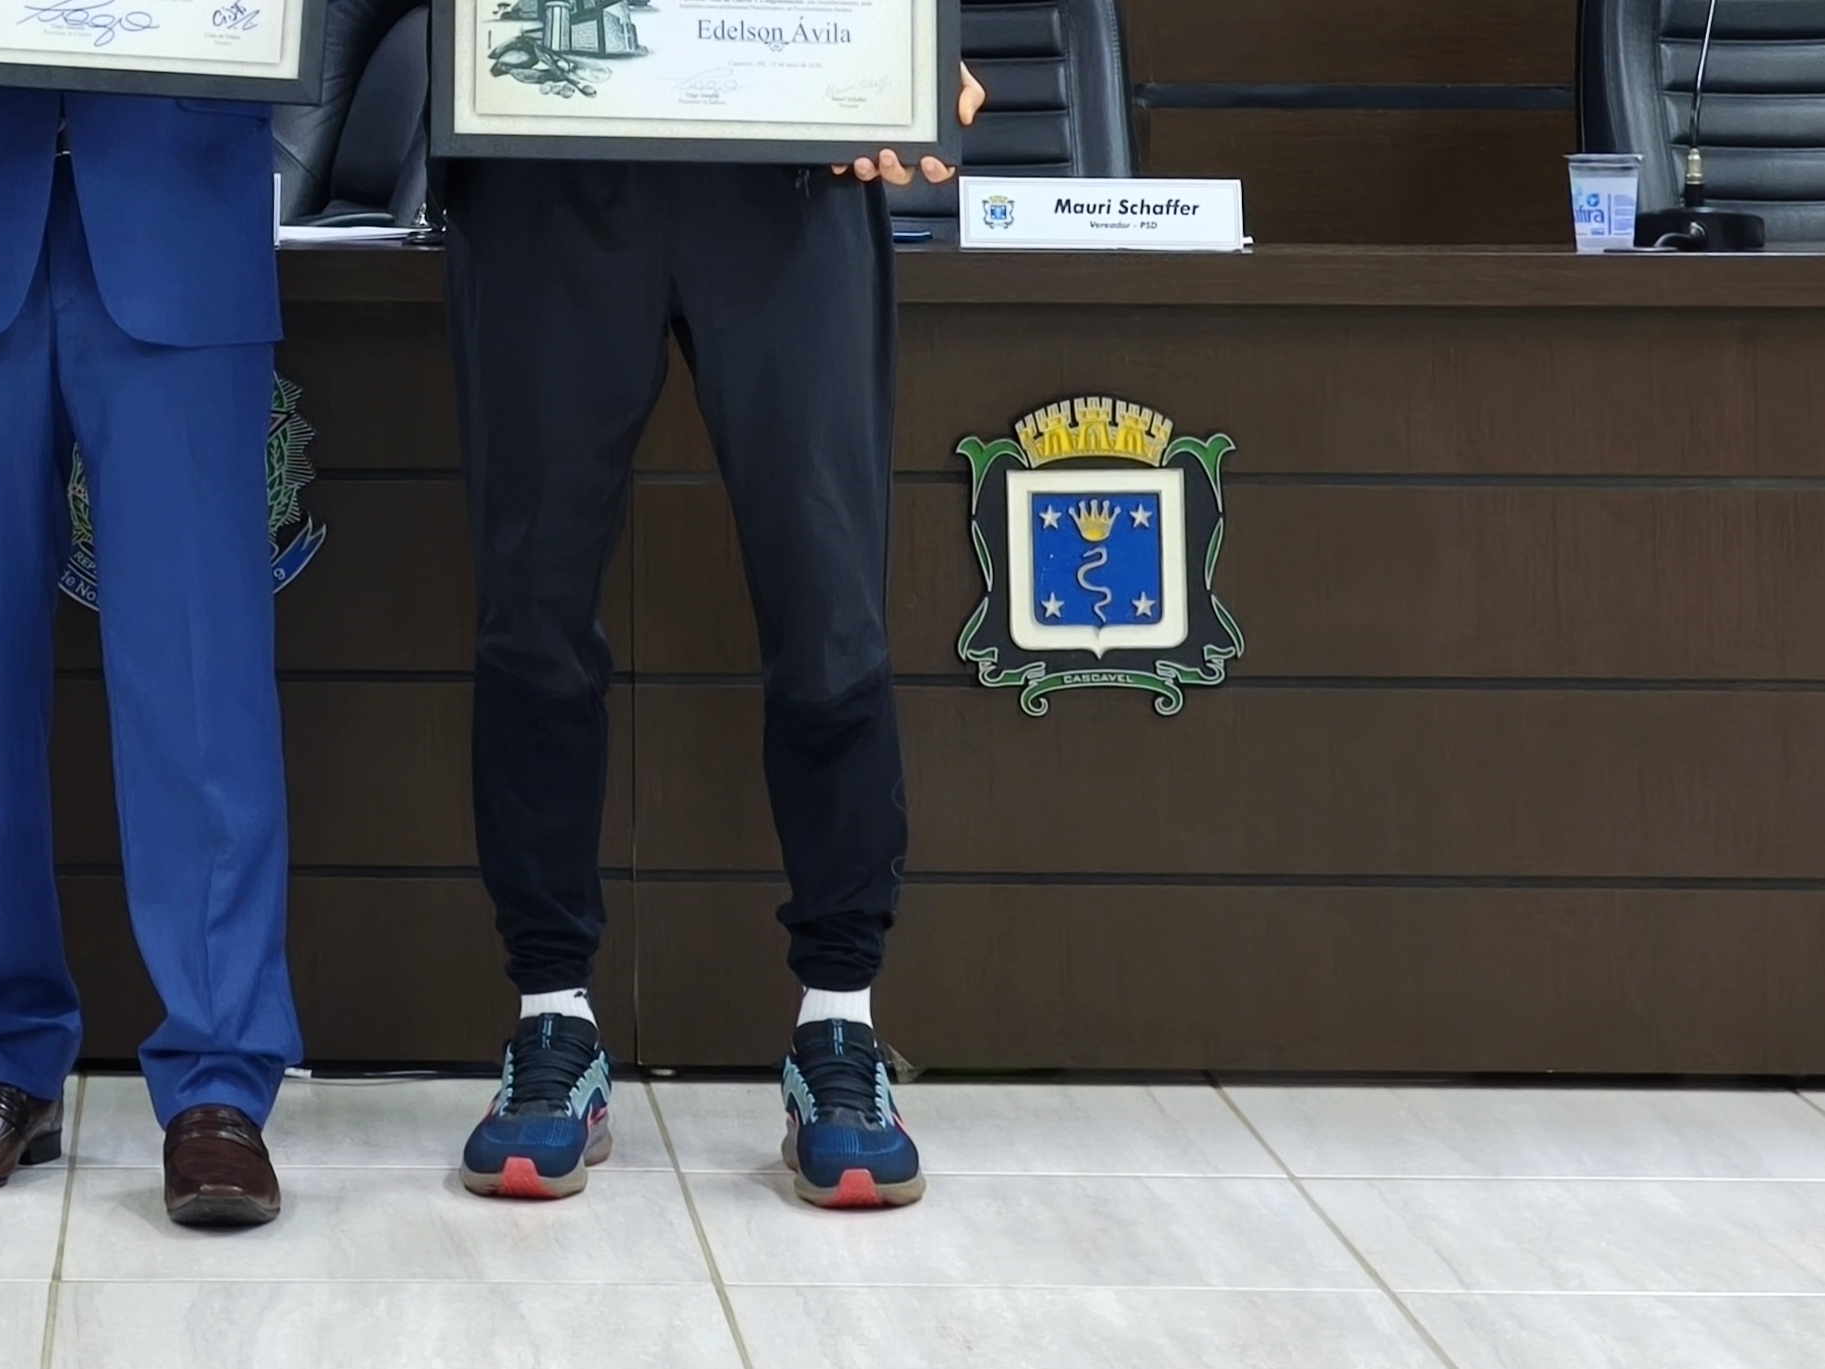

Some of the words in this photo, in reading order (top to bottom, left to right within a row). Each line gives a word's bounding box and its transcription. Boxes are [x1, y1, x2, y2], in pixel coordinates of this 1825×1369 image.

[697, 19, 784, 43] Edelson
[792, 16, 852, 44] Ávila
[1054, 198, 1112, 215] Mauri
[1118, 199, 1200, 216] Schaffer
[1089, 220, 1131, 229] Vereador
